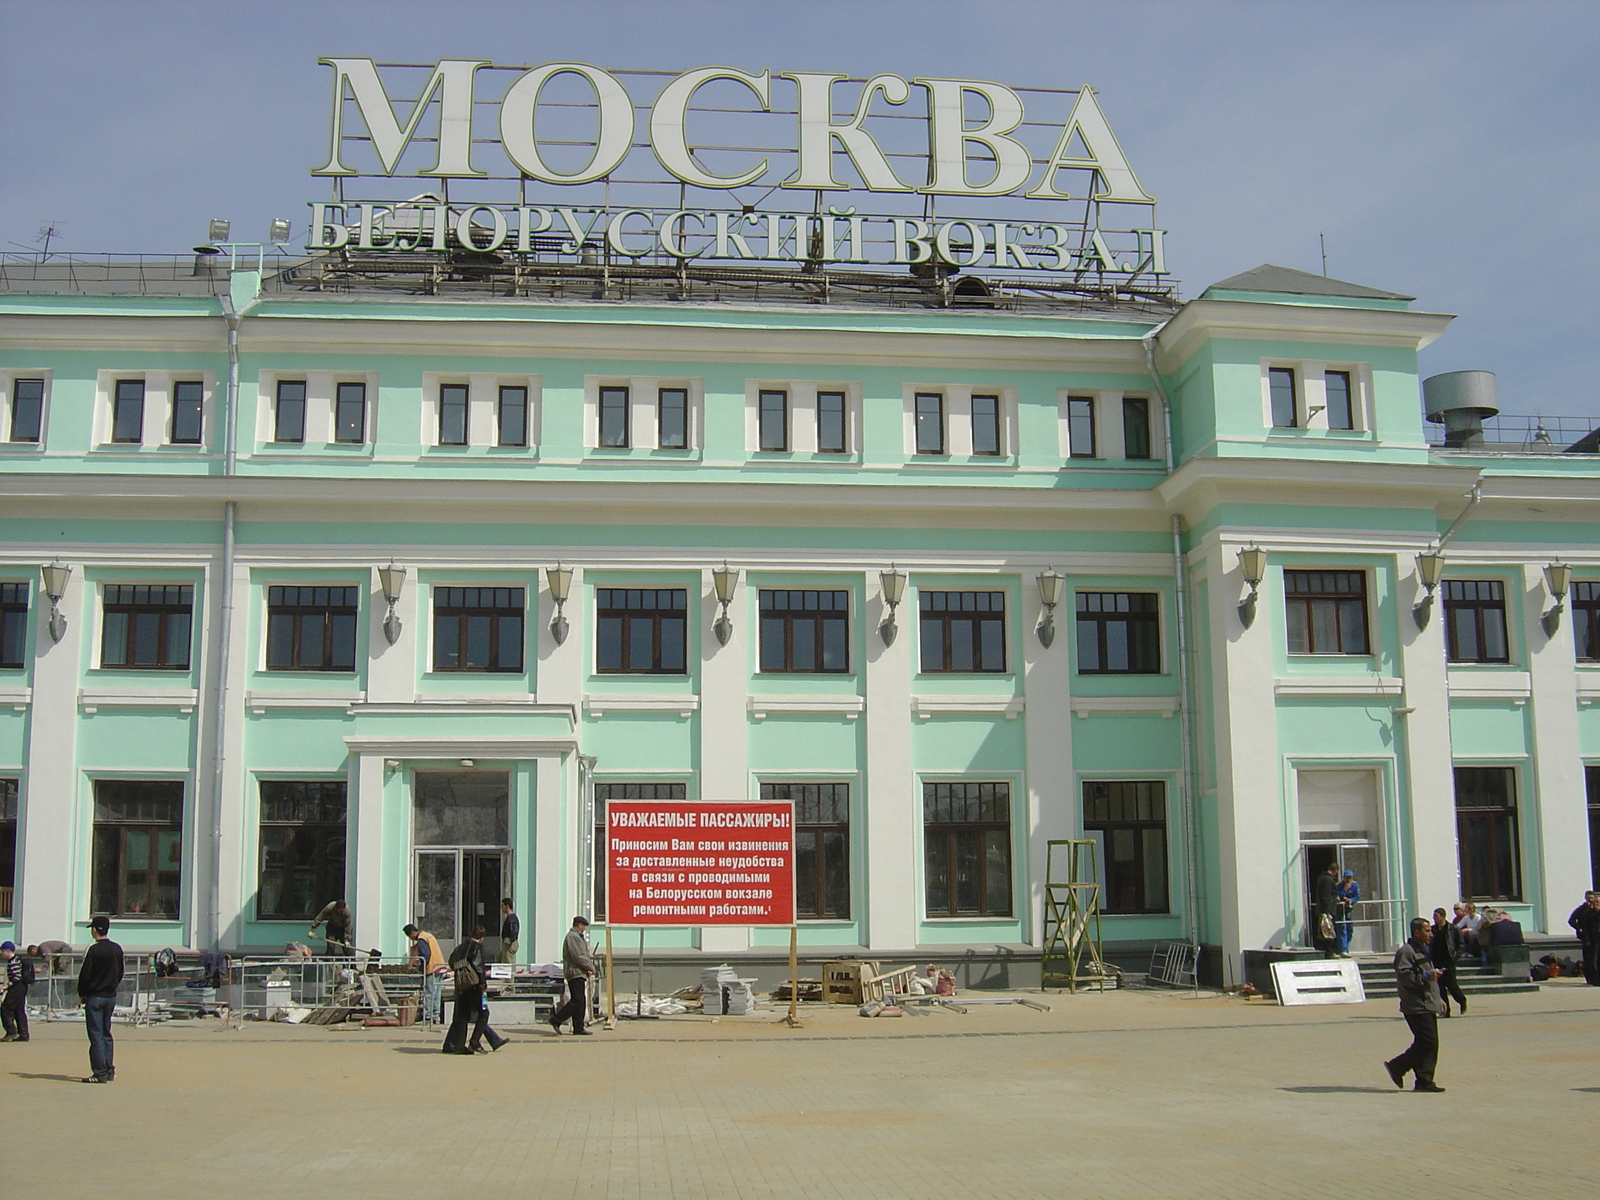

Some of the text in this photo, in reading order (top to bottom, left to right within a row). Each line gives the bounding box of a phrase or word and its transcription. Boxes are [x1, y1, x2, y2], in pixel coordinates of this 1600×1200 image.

[310, 56, 1157, 205] МОСКВА
[304, 201, 1171, 275] БЕЛОРУССКИЙ ВОКЗАЛ
[611, 812, 790, 828] УВАЖАЕМЫЕ ПАССАЖИРЫ!
[611, 838, 789, 852] Приносим Вам свои извинения
[616, 855, 784, 869] за доставленные неудобства
[631, 873, 770, 885] в связи с проводимыми
[629, 887, 773, 901] на Белорусском вокзале
[633, 903, 769, 917] ремонтными работами.
